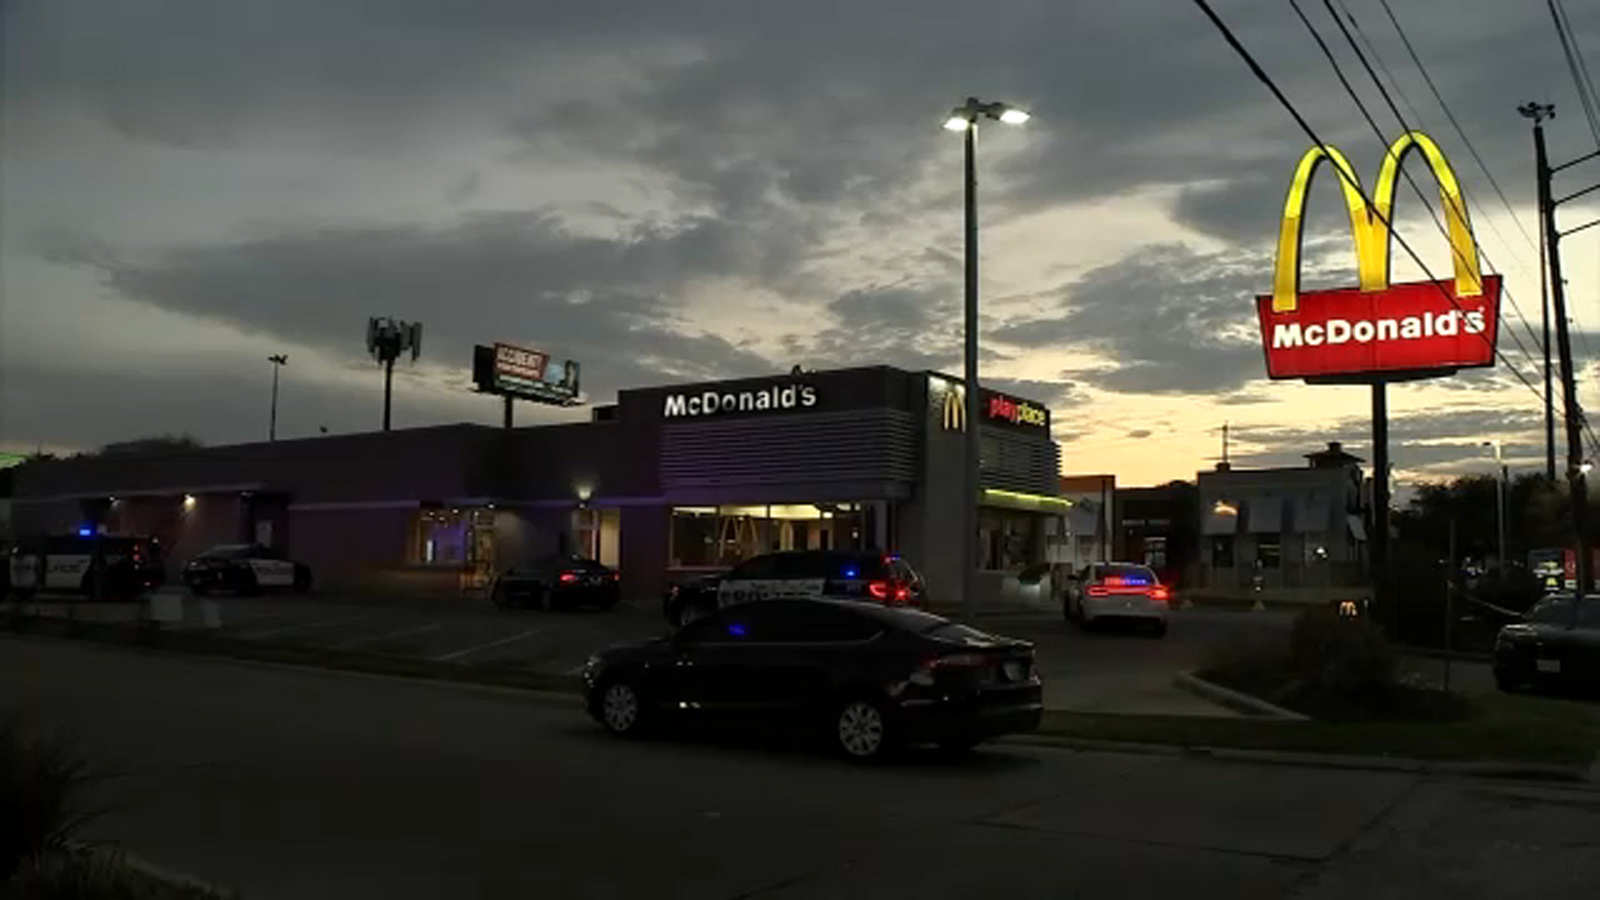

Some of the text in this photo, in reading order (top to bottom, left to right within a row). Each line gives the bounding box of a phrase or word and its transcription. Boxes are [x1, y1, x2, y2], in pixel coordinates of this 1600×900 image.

[1272, 309, 1485, 349] McDonald's
[664, 384, 817, 418] McDonald's
[989, 395, 1047, 426] playplace
